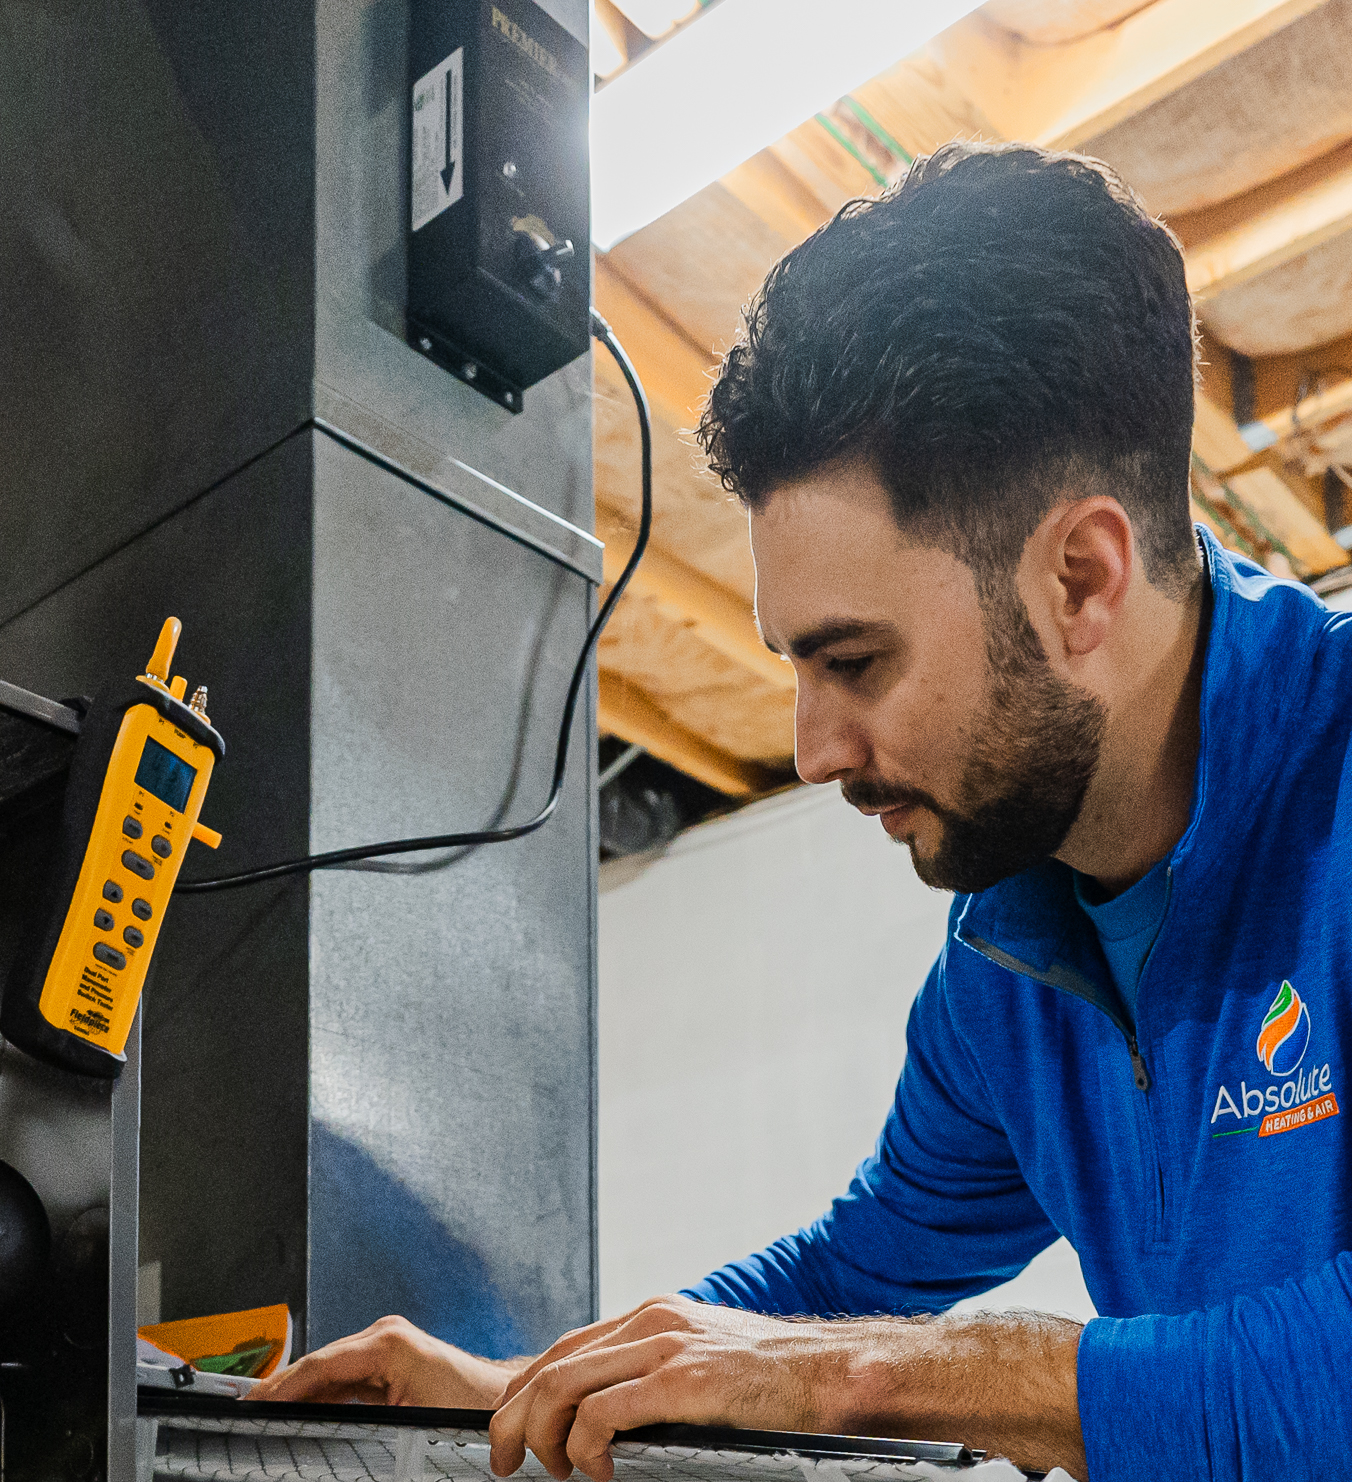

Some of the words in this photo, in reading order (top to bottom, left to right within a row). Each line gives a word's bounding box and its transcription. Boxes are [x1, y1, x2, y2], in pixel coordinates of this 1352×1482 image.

[84, 966, 97, 977] Dual
[97, 970, 109, 983] Port
[70, 1008, 110, 1033] Fieldpiece
[1210, 1063, 1332, 1124] Absolute
[1265, 1109, 1305, 1133] HEATING
[1307, 1107, 1314, 1120] &
[1315, 1099, 1334, 1118] AIR
